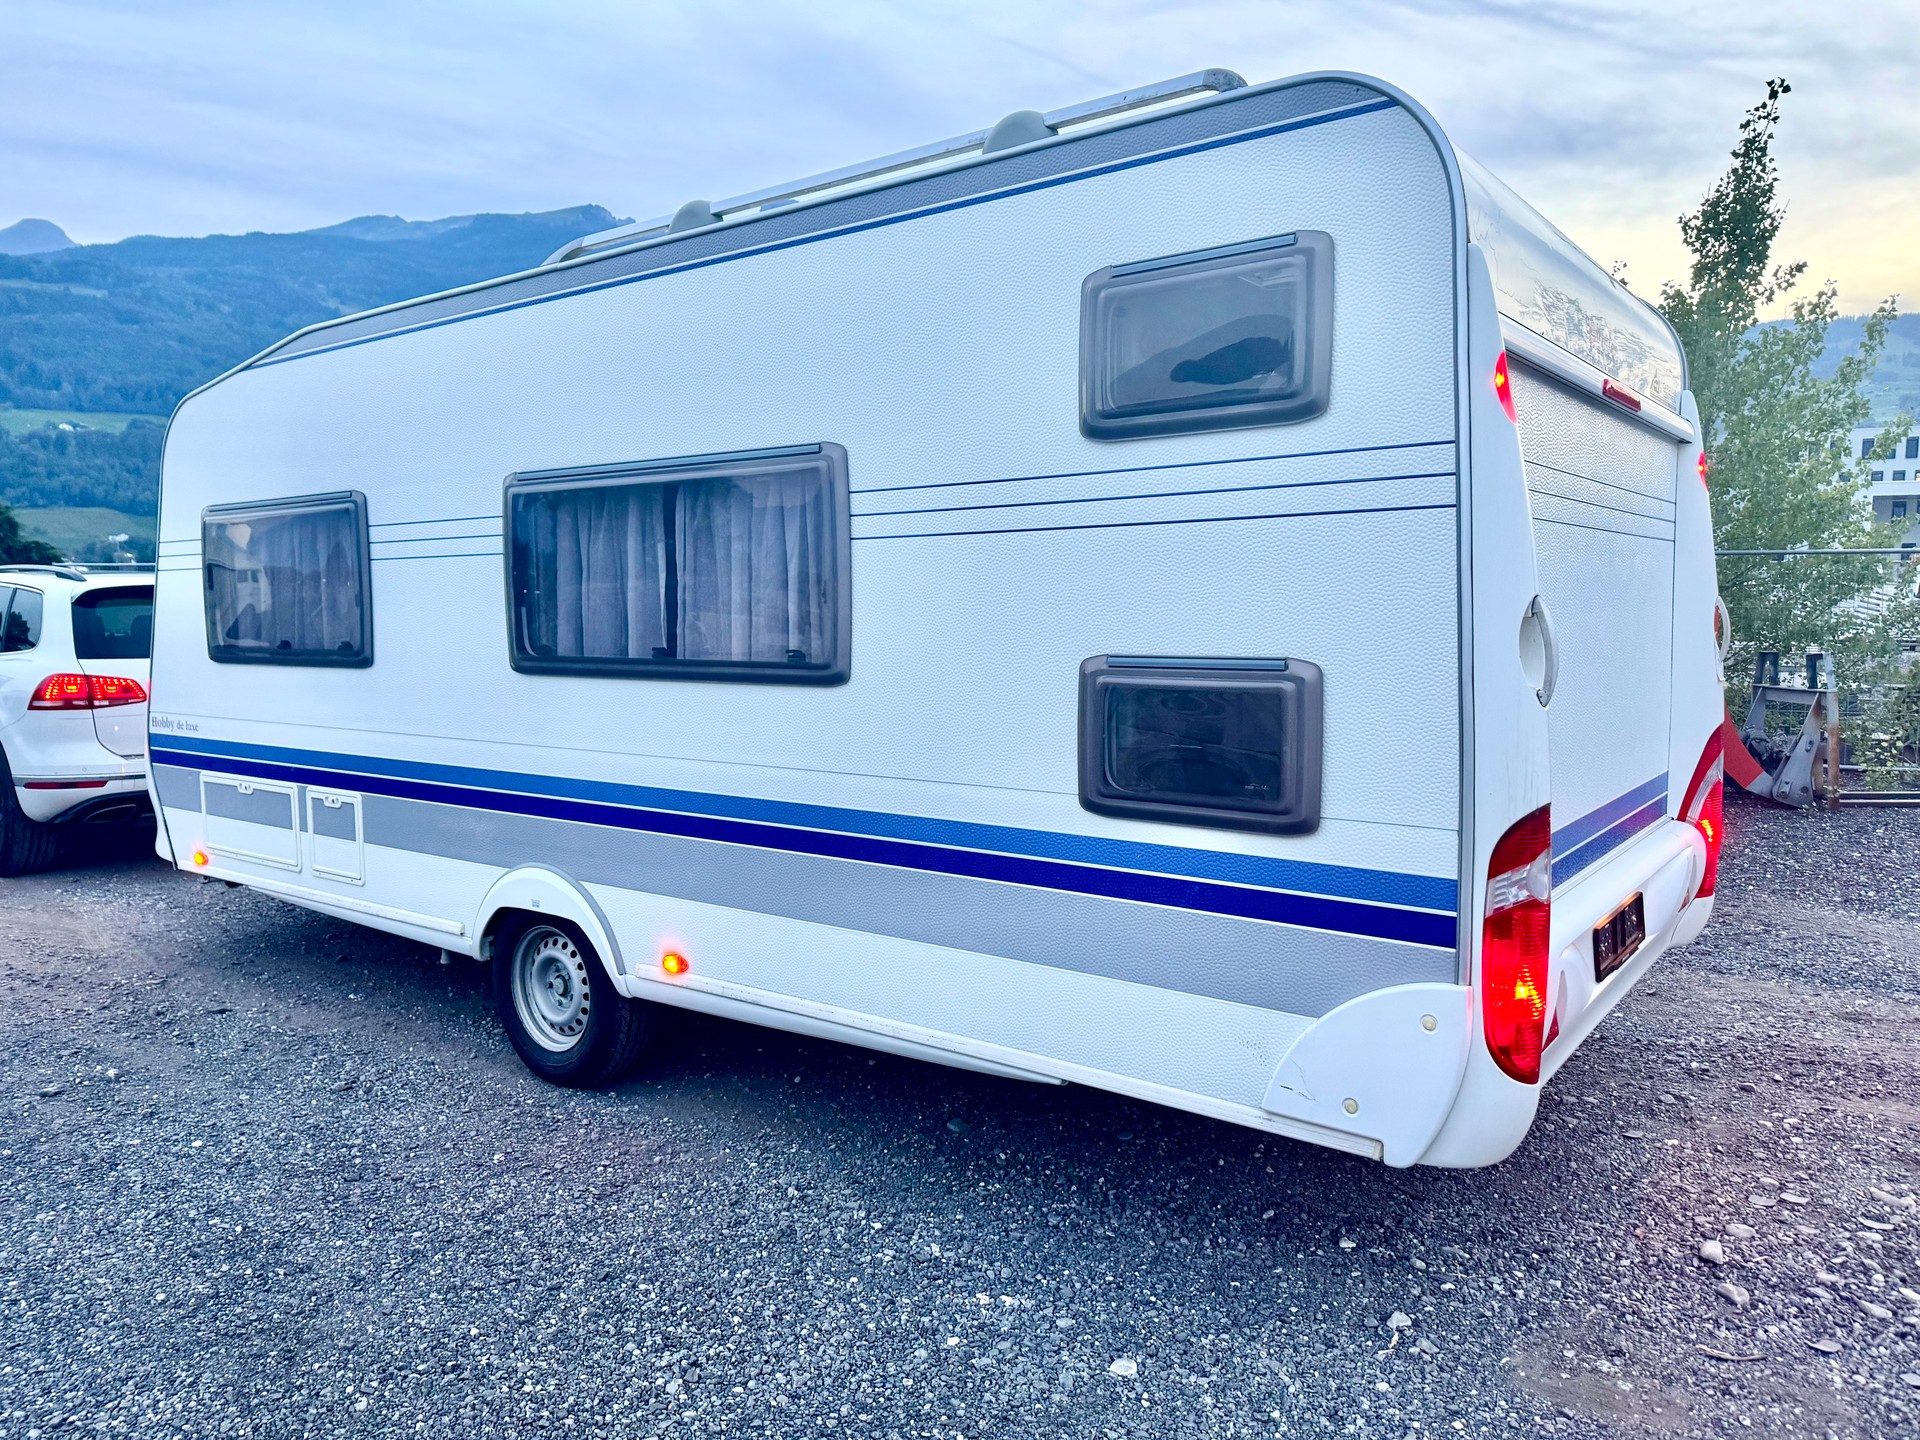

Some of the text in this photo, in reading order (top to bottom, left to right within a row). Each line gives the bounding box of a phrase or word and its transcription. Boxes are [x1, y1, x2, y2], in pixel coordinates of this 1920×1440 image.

[151, 716, 199, 732] Hobby de luxe
